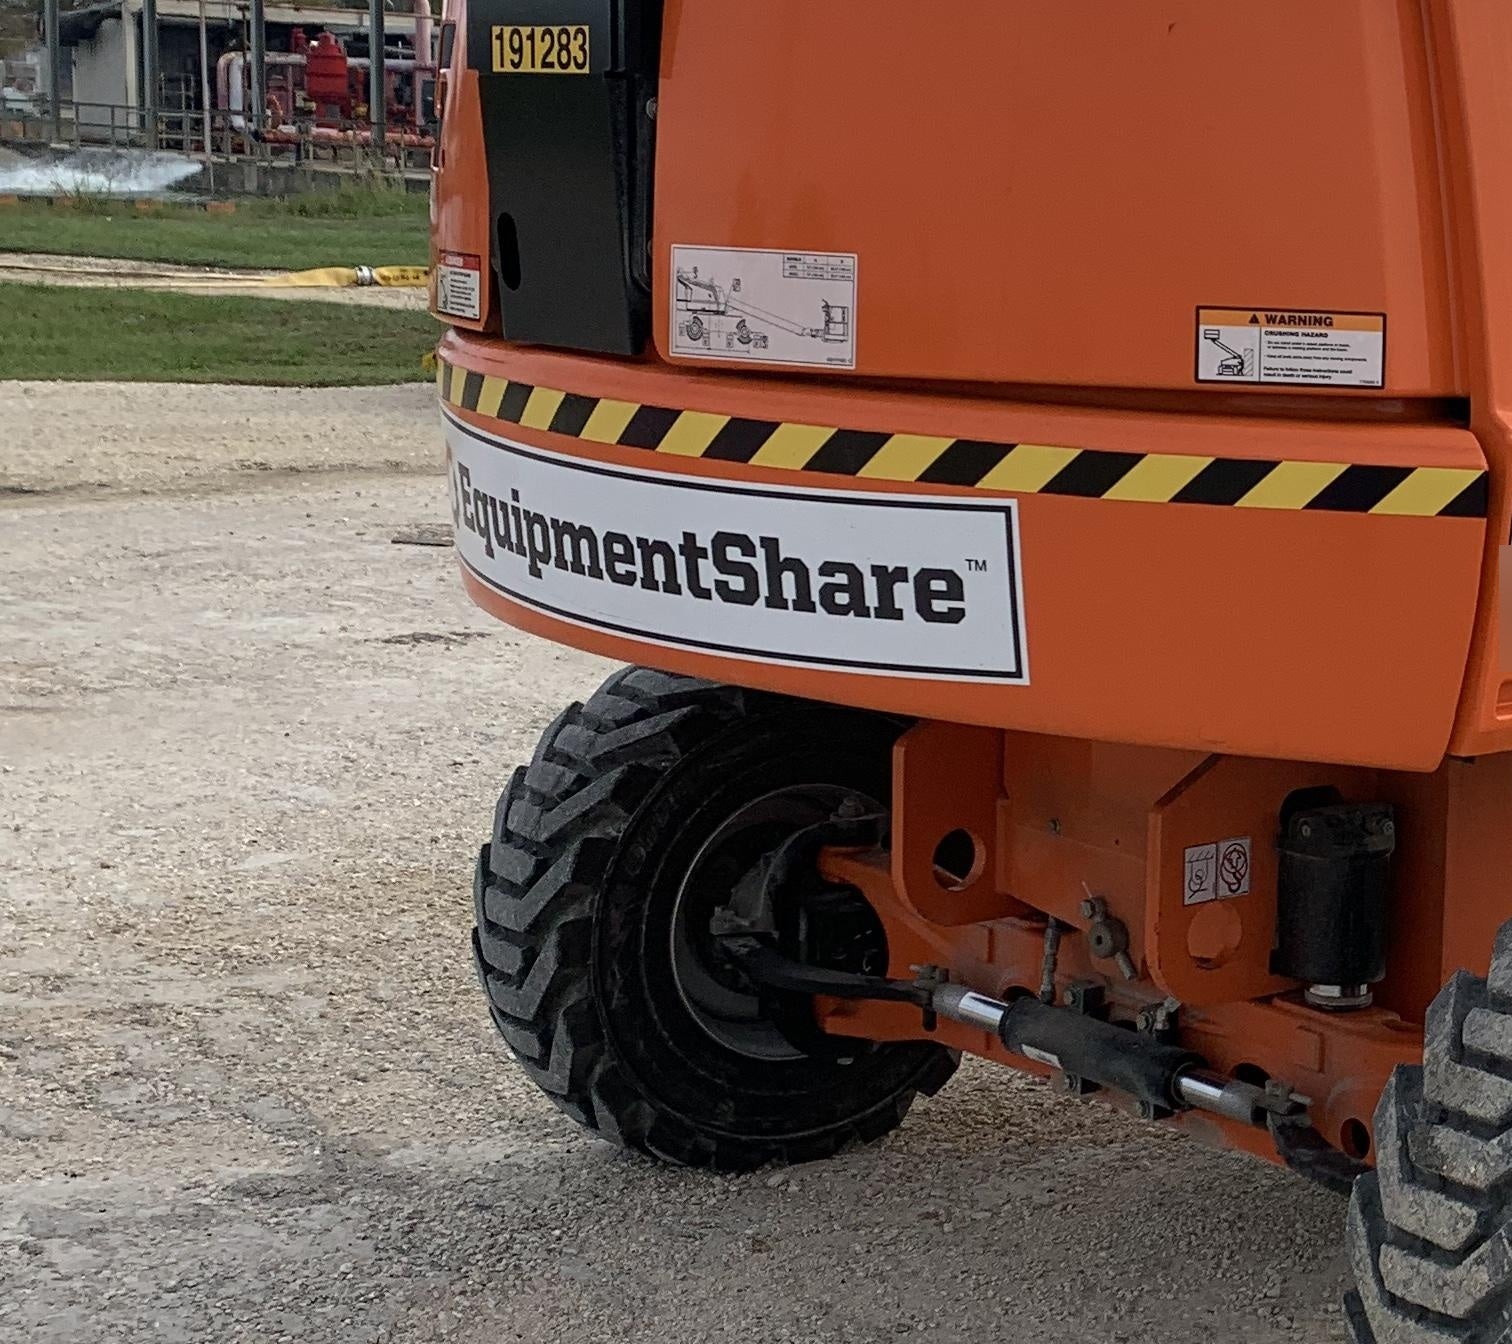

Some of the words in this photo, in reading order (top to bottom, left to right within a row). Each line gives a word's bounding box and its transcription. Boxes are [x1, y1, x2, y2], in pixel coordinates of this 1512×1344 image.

[495, 27, 587, 70] 191283
[1265, 314, 1333, 326] WARNING
[458, 461, 966, 625] EquipmentShare
